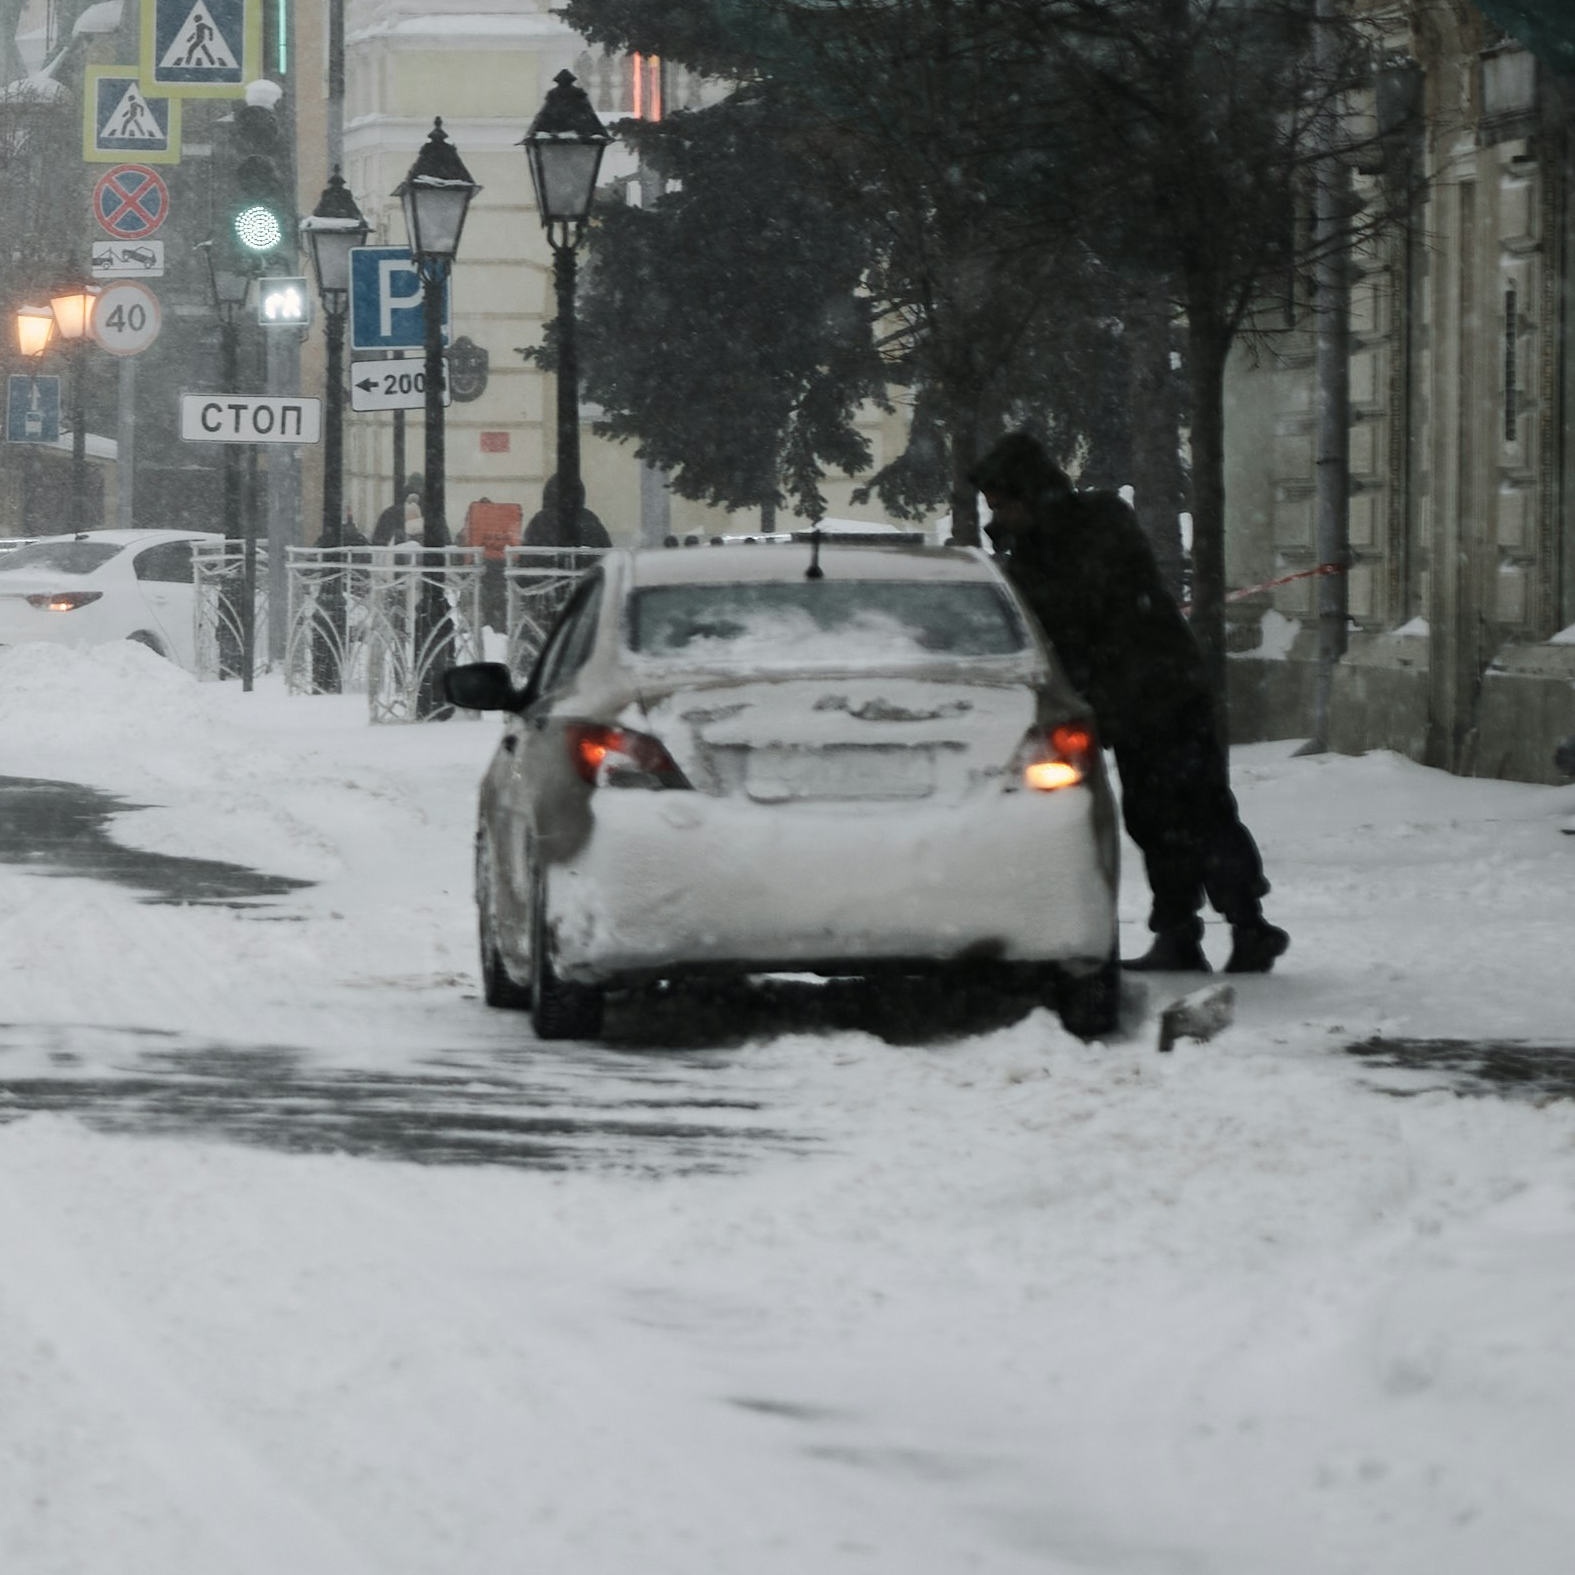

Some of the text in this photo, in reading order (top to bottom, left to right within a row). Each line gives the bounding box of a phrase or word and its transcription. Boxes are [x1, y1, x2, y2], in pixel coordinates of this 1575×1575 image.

[378, 259, 426, 337] P
[105, 303, 146, 333] 40
[383, 372, 426, 395] 200
[201, 402, 302, 436] СТОП
